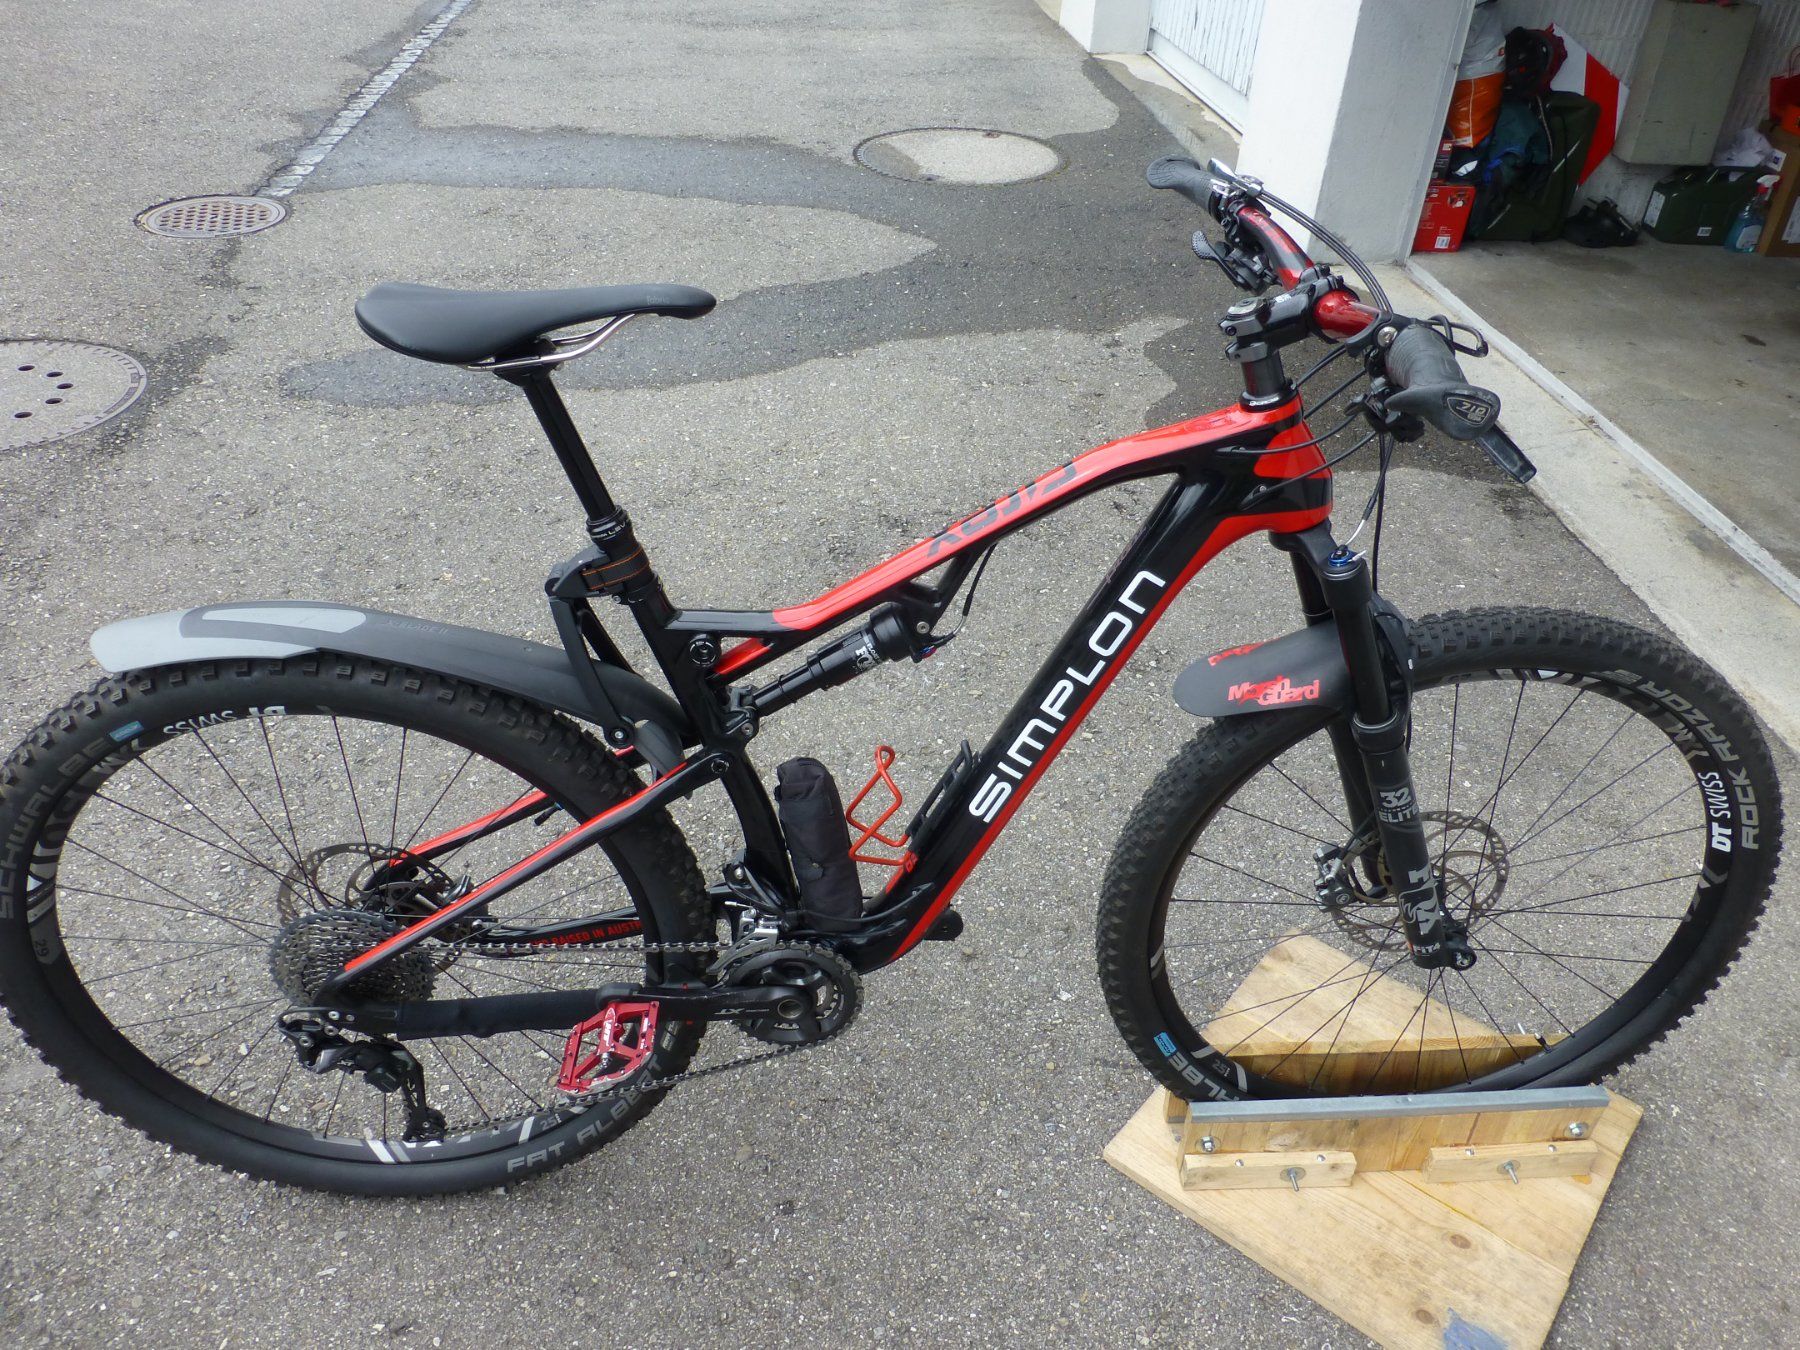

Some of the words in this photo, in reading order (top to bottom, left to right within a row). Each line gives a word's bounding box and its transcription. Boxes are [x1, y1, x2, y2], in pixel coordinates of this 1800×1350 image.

[968, 570, 1166, 823] SIMPLON
[162, 710, 238, 738] SWISS
[1636, 680, 1740, 762] RAZOR
[1379, 786, 1411, 808] 32
[1697, 771, 1731, 818] SWISS
[1727, 766, 1760, 850] ROCK
[1378, 804, 1420, 823] ELITE
[1711, 821, 1733, 853] DT
[507, 1141, 566, 1173] FAT
